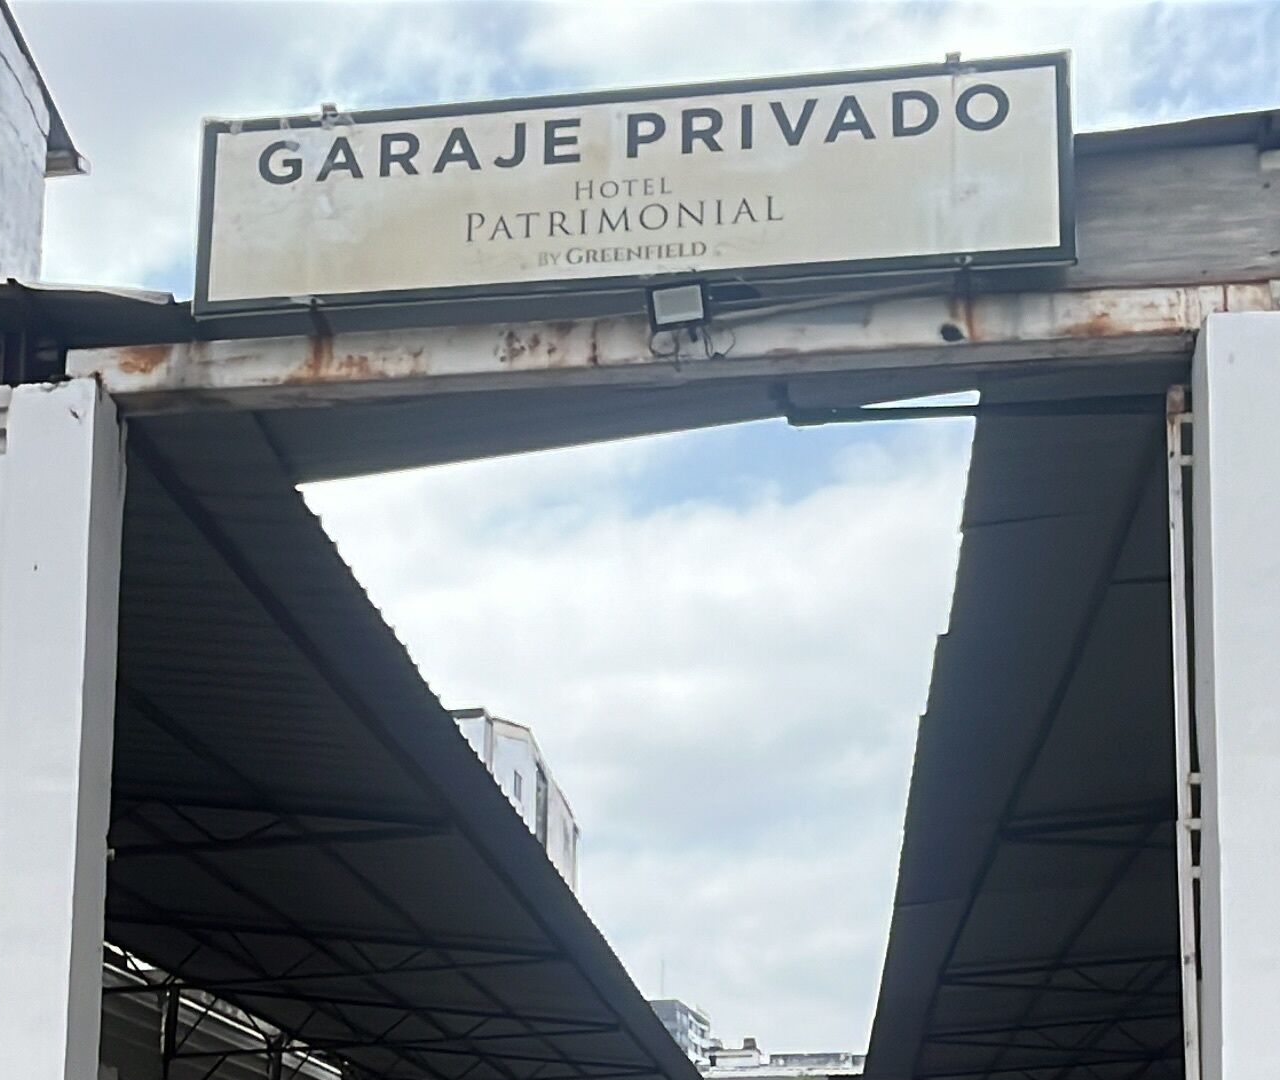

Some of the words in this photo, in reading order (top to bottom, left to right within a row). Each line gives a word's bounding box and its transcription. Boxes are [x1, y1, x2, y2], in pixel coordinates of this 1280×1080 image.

[258, 118, 581, 185] GARAJE
[625, 83, 1010, 159] PRIVADO
[574, 176, 673, 201] HOTEL
[465, 195, 784, 243] PATRIMONIAL
[538, 251, 561, 267] BY
[565, 240, 707, 265] GREENFIELD
